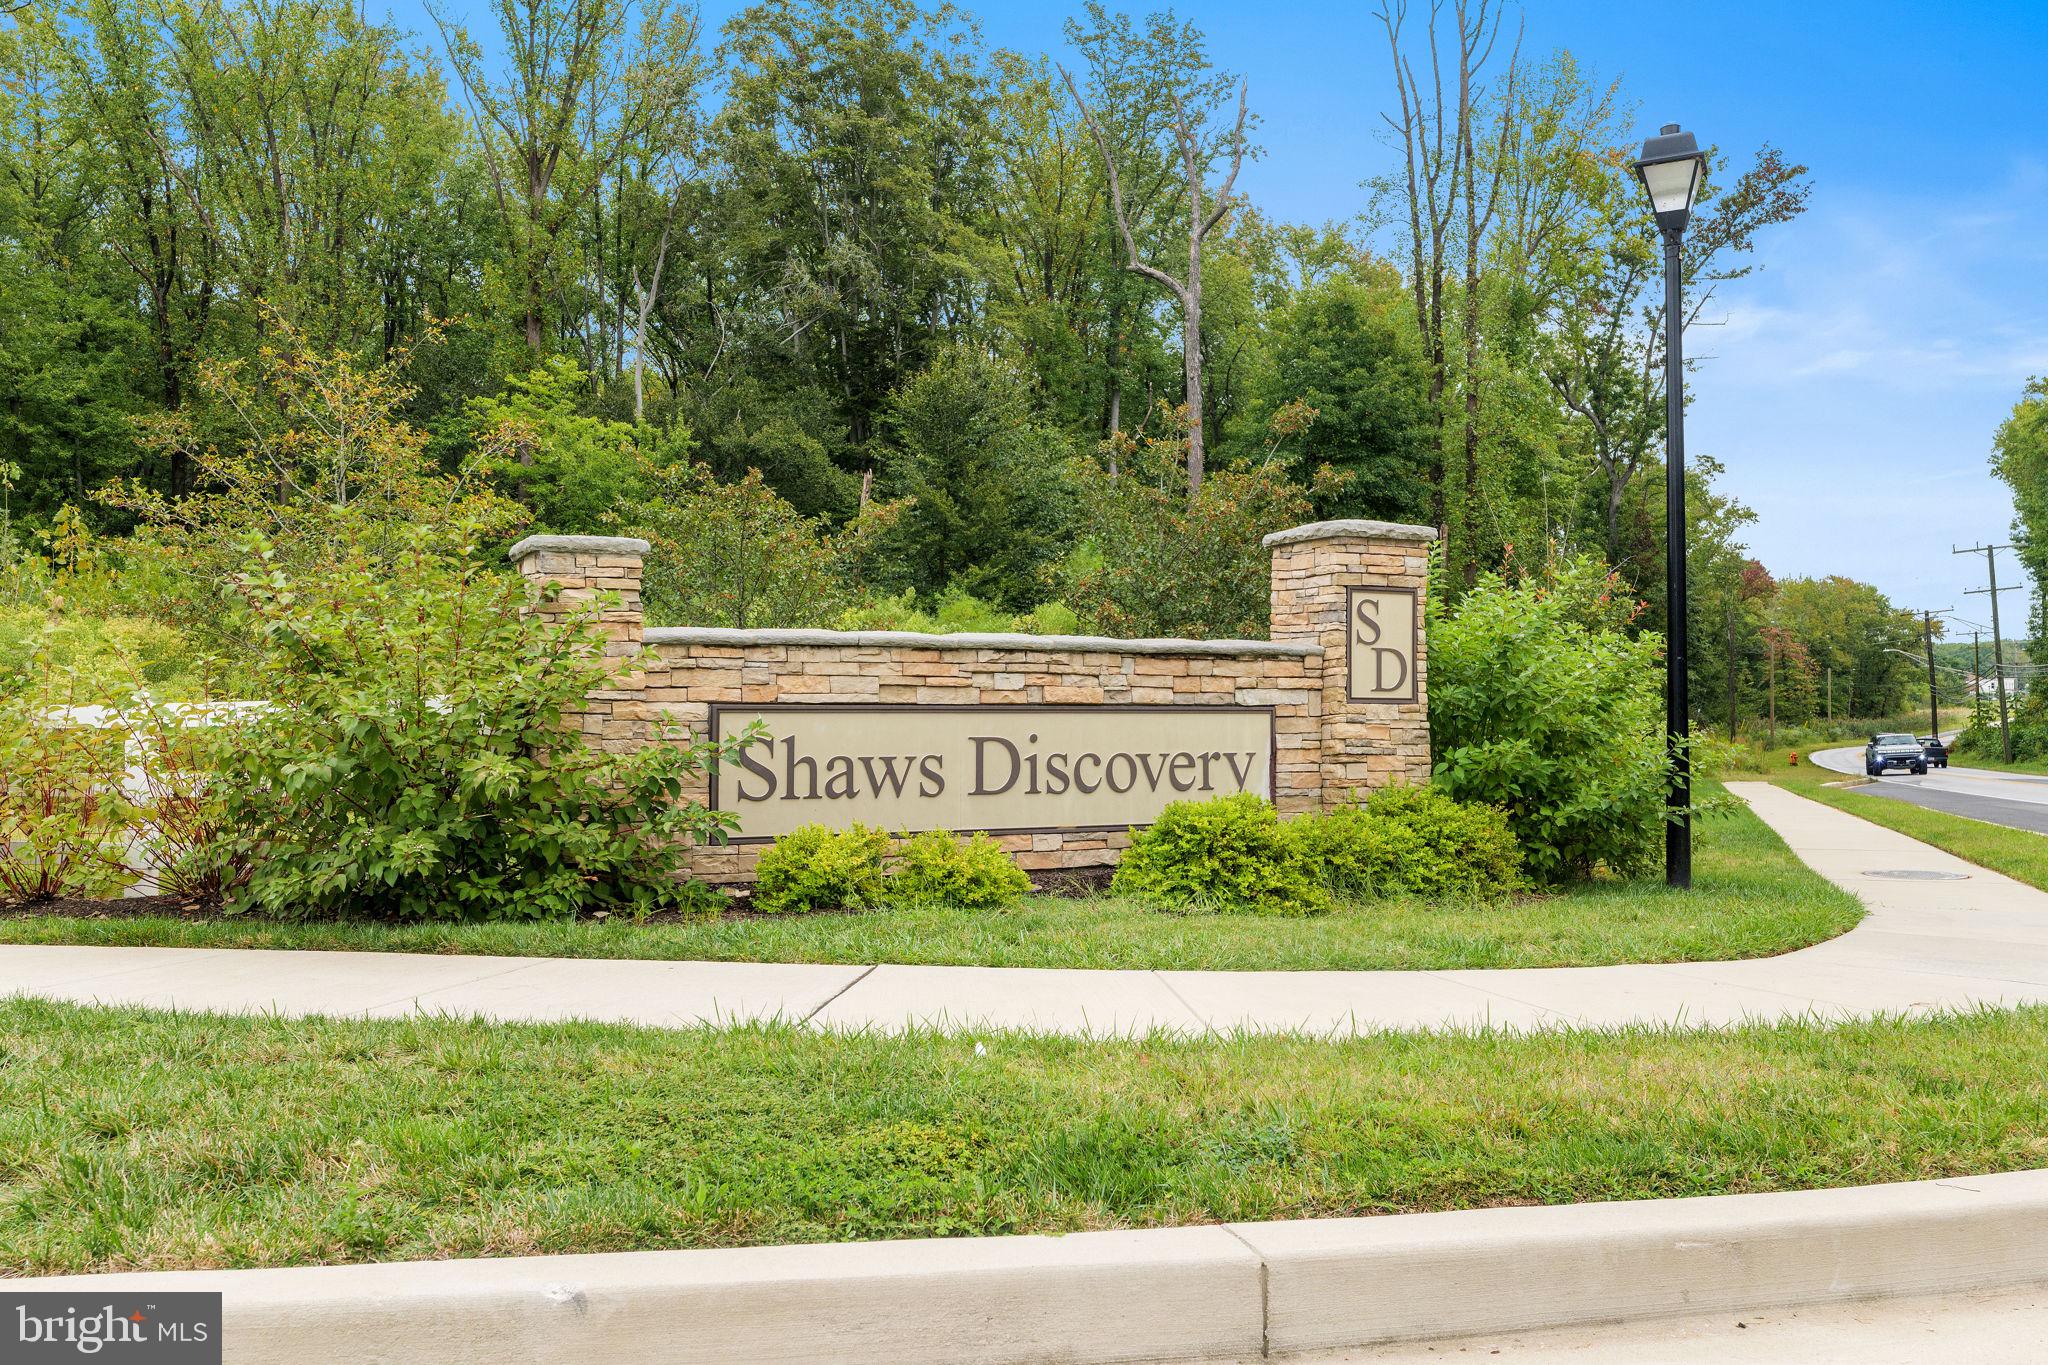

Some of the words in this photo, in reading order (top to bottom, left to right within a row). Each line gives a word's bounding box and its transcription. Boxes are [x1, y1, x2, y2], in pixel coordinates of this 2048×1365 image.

[1356, 598, 1381, 646] S
[1370, 647, 1408, 692] D
[737, 734, 945, 802] Shaws
[967, 733, 1257, 797] Discovery
